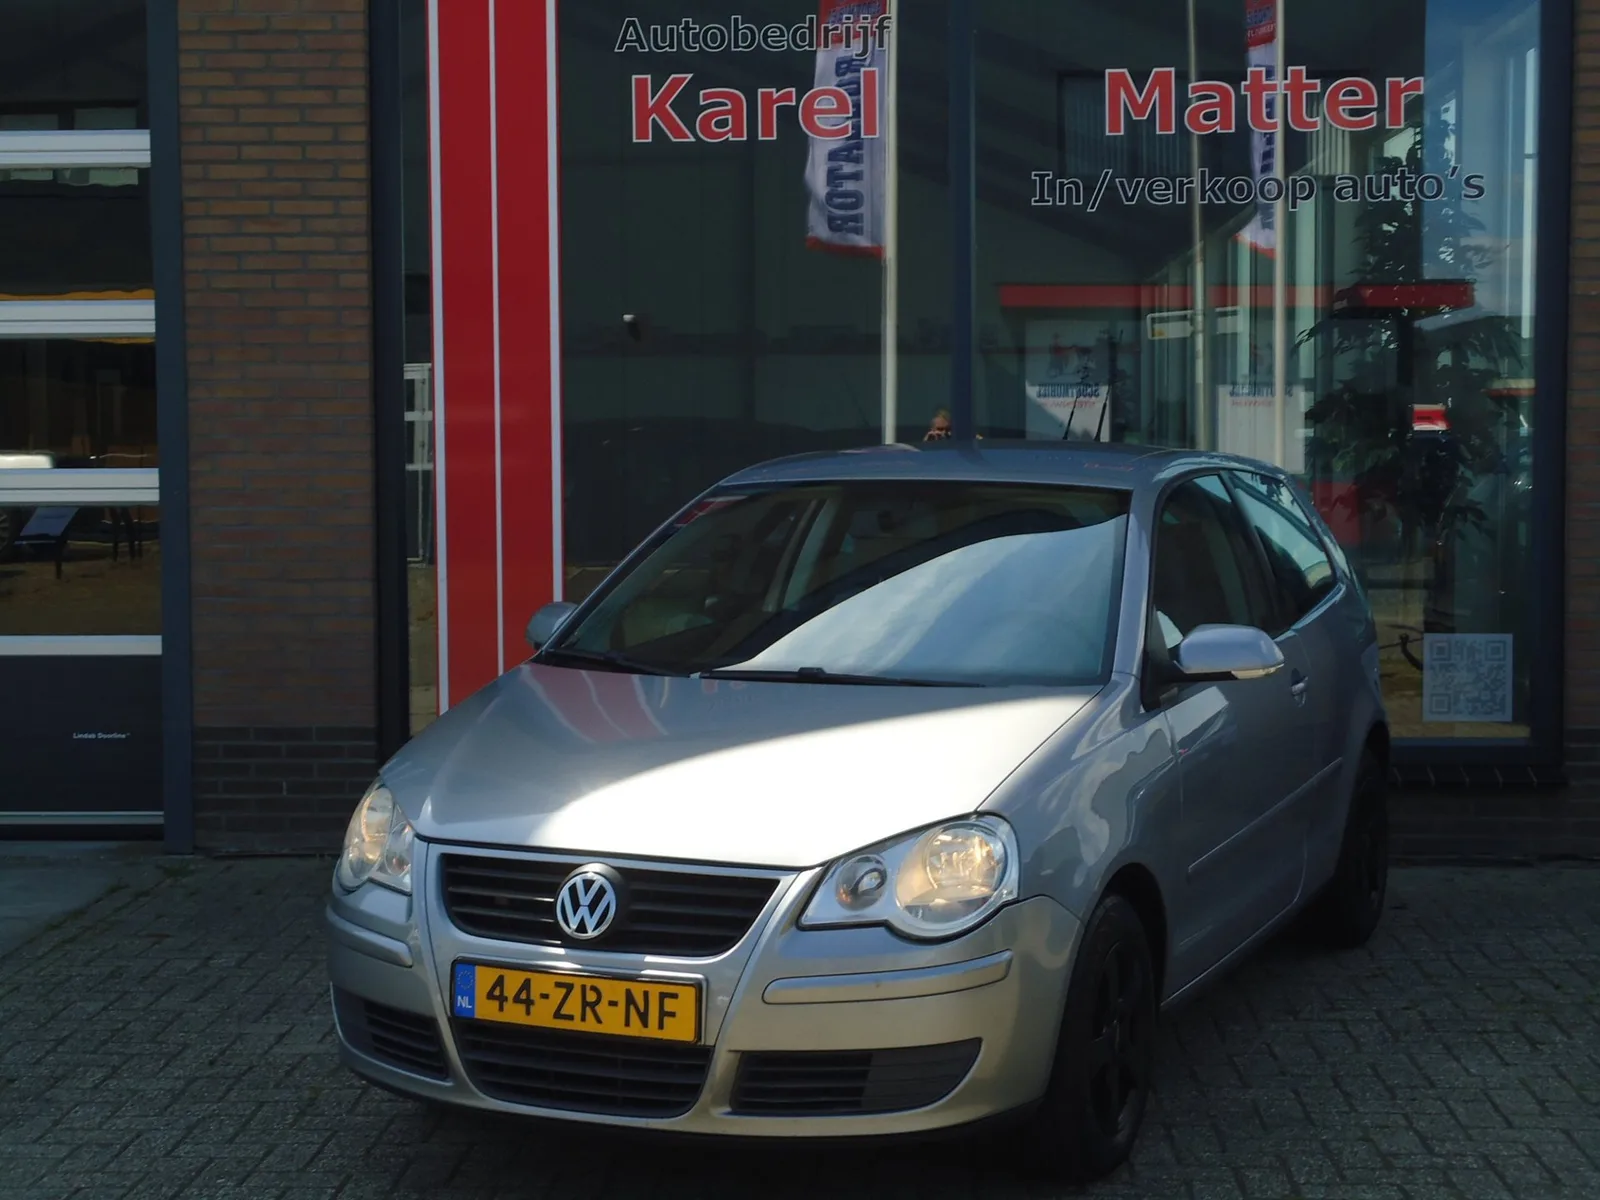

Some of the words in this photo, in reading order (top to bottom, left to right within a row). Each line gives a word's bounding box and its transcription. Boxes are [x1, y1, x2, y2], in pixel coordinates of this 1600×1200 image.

[615, 14, 893, 57] Autobedrijf
[631, 68, 881, 142] Karel
[1104, 65, 1425, 136] Matter
[1031, 168, 1317, 212] In/verkoop
[1334, 166, 1486, 203] auto's
[457, 995, 473, 1009] NL
[485, 974, 679, 1030] 44-ZR-NF
